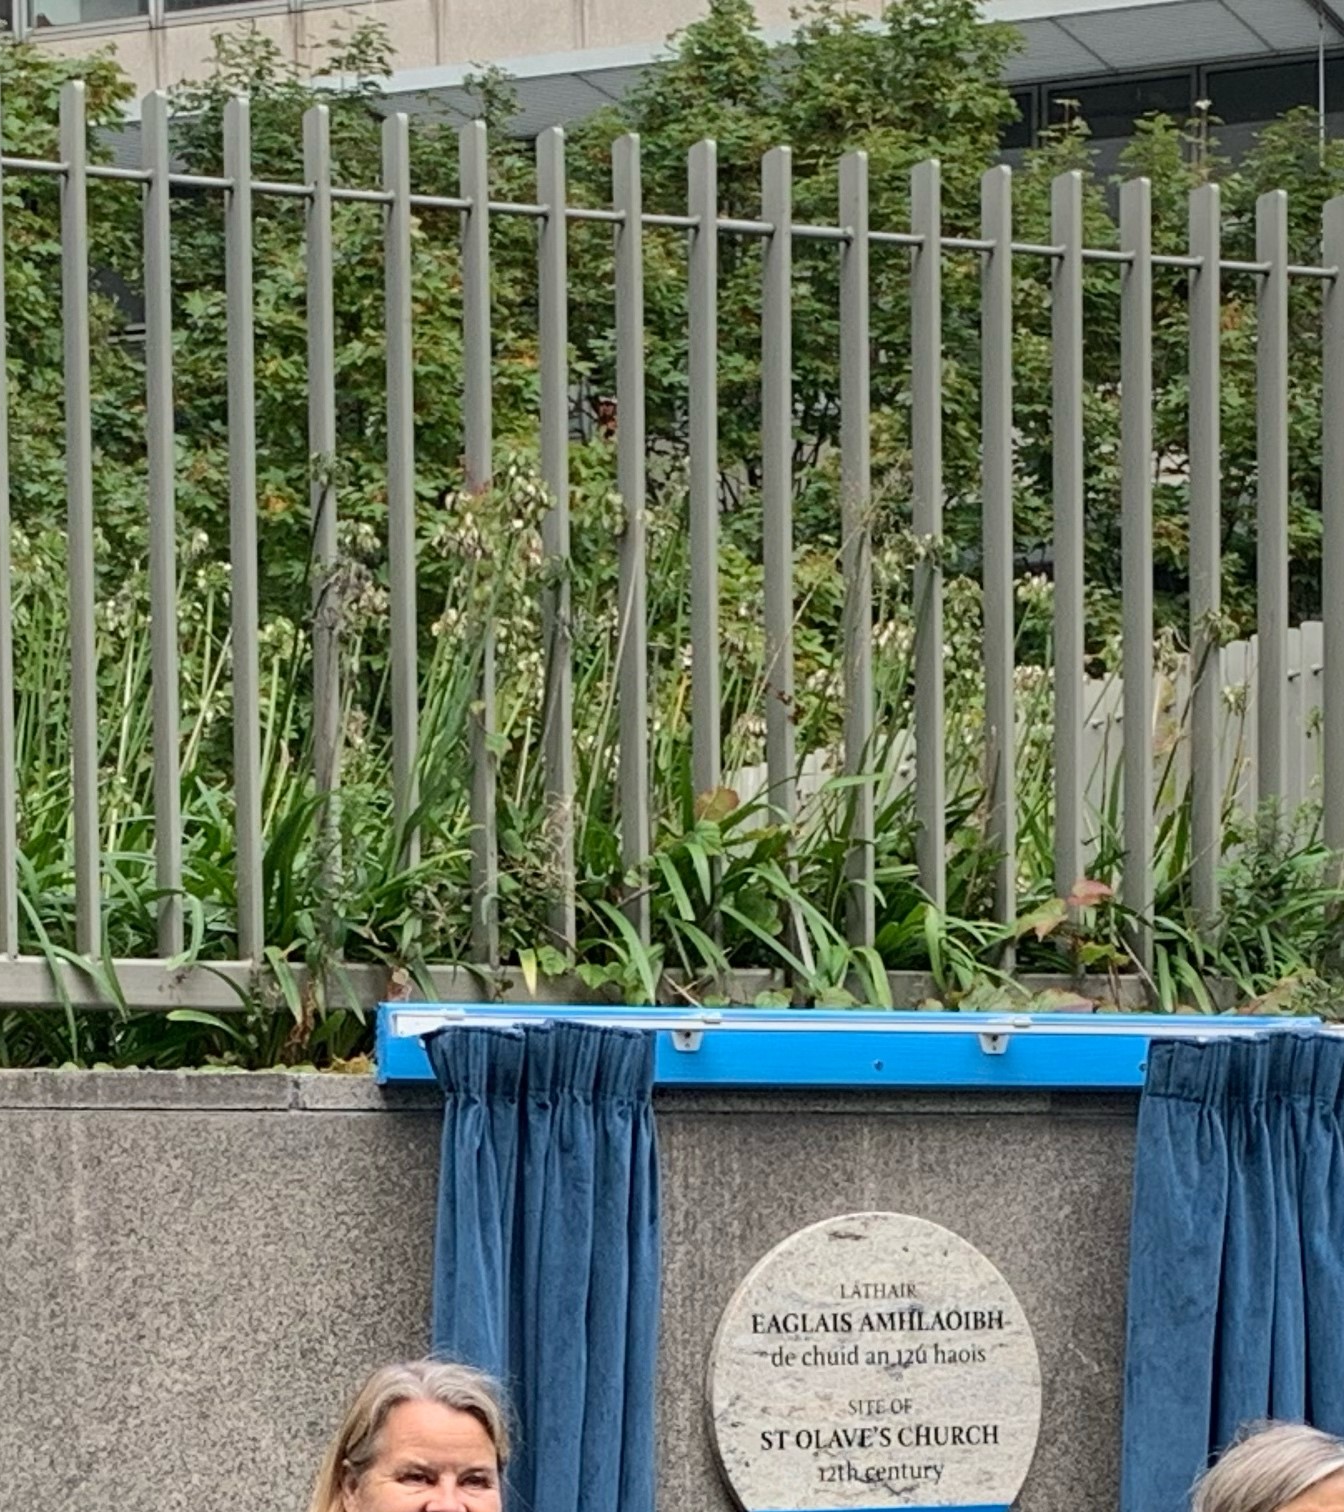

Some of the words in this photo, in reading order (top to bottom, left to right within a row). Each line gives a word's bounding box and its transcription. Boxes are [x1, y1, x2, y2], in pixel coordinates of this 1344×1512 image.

[752, 1312, 853, 1334] EAGLAIS
[771, 1346, 797, 1367] de
[801, 1345, 859, 1367] chuid
[865, 1351, 890, 1365] an
[933, 1343, 987, 1364] haois
[848, 1399, 886, 1416] SITE
[890, 1398, 914, 1414] OF
[760, 1430, 790, 1450] ST
[897, 1424, 999, 1447] CHURCH
[818, 1460, 857, 1483] 12th
[864, 1462, 944, 1484] century
